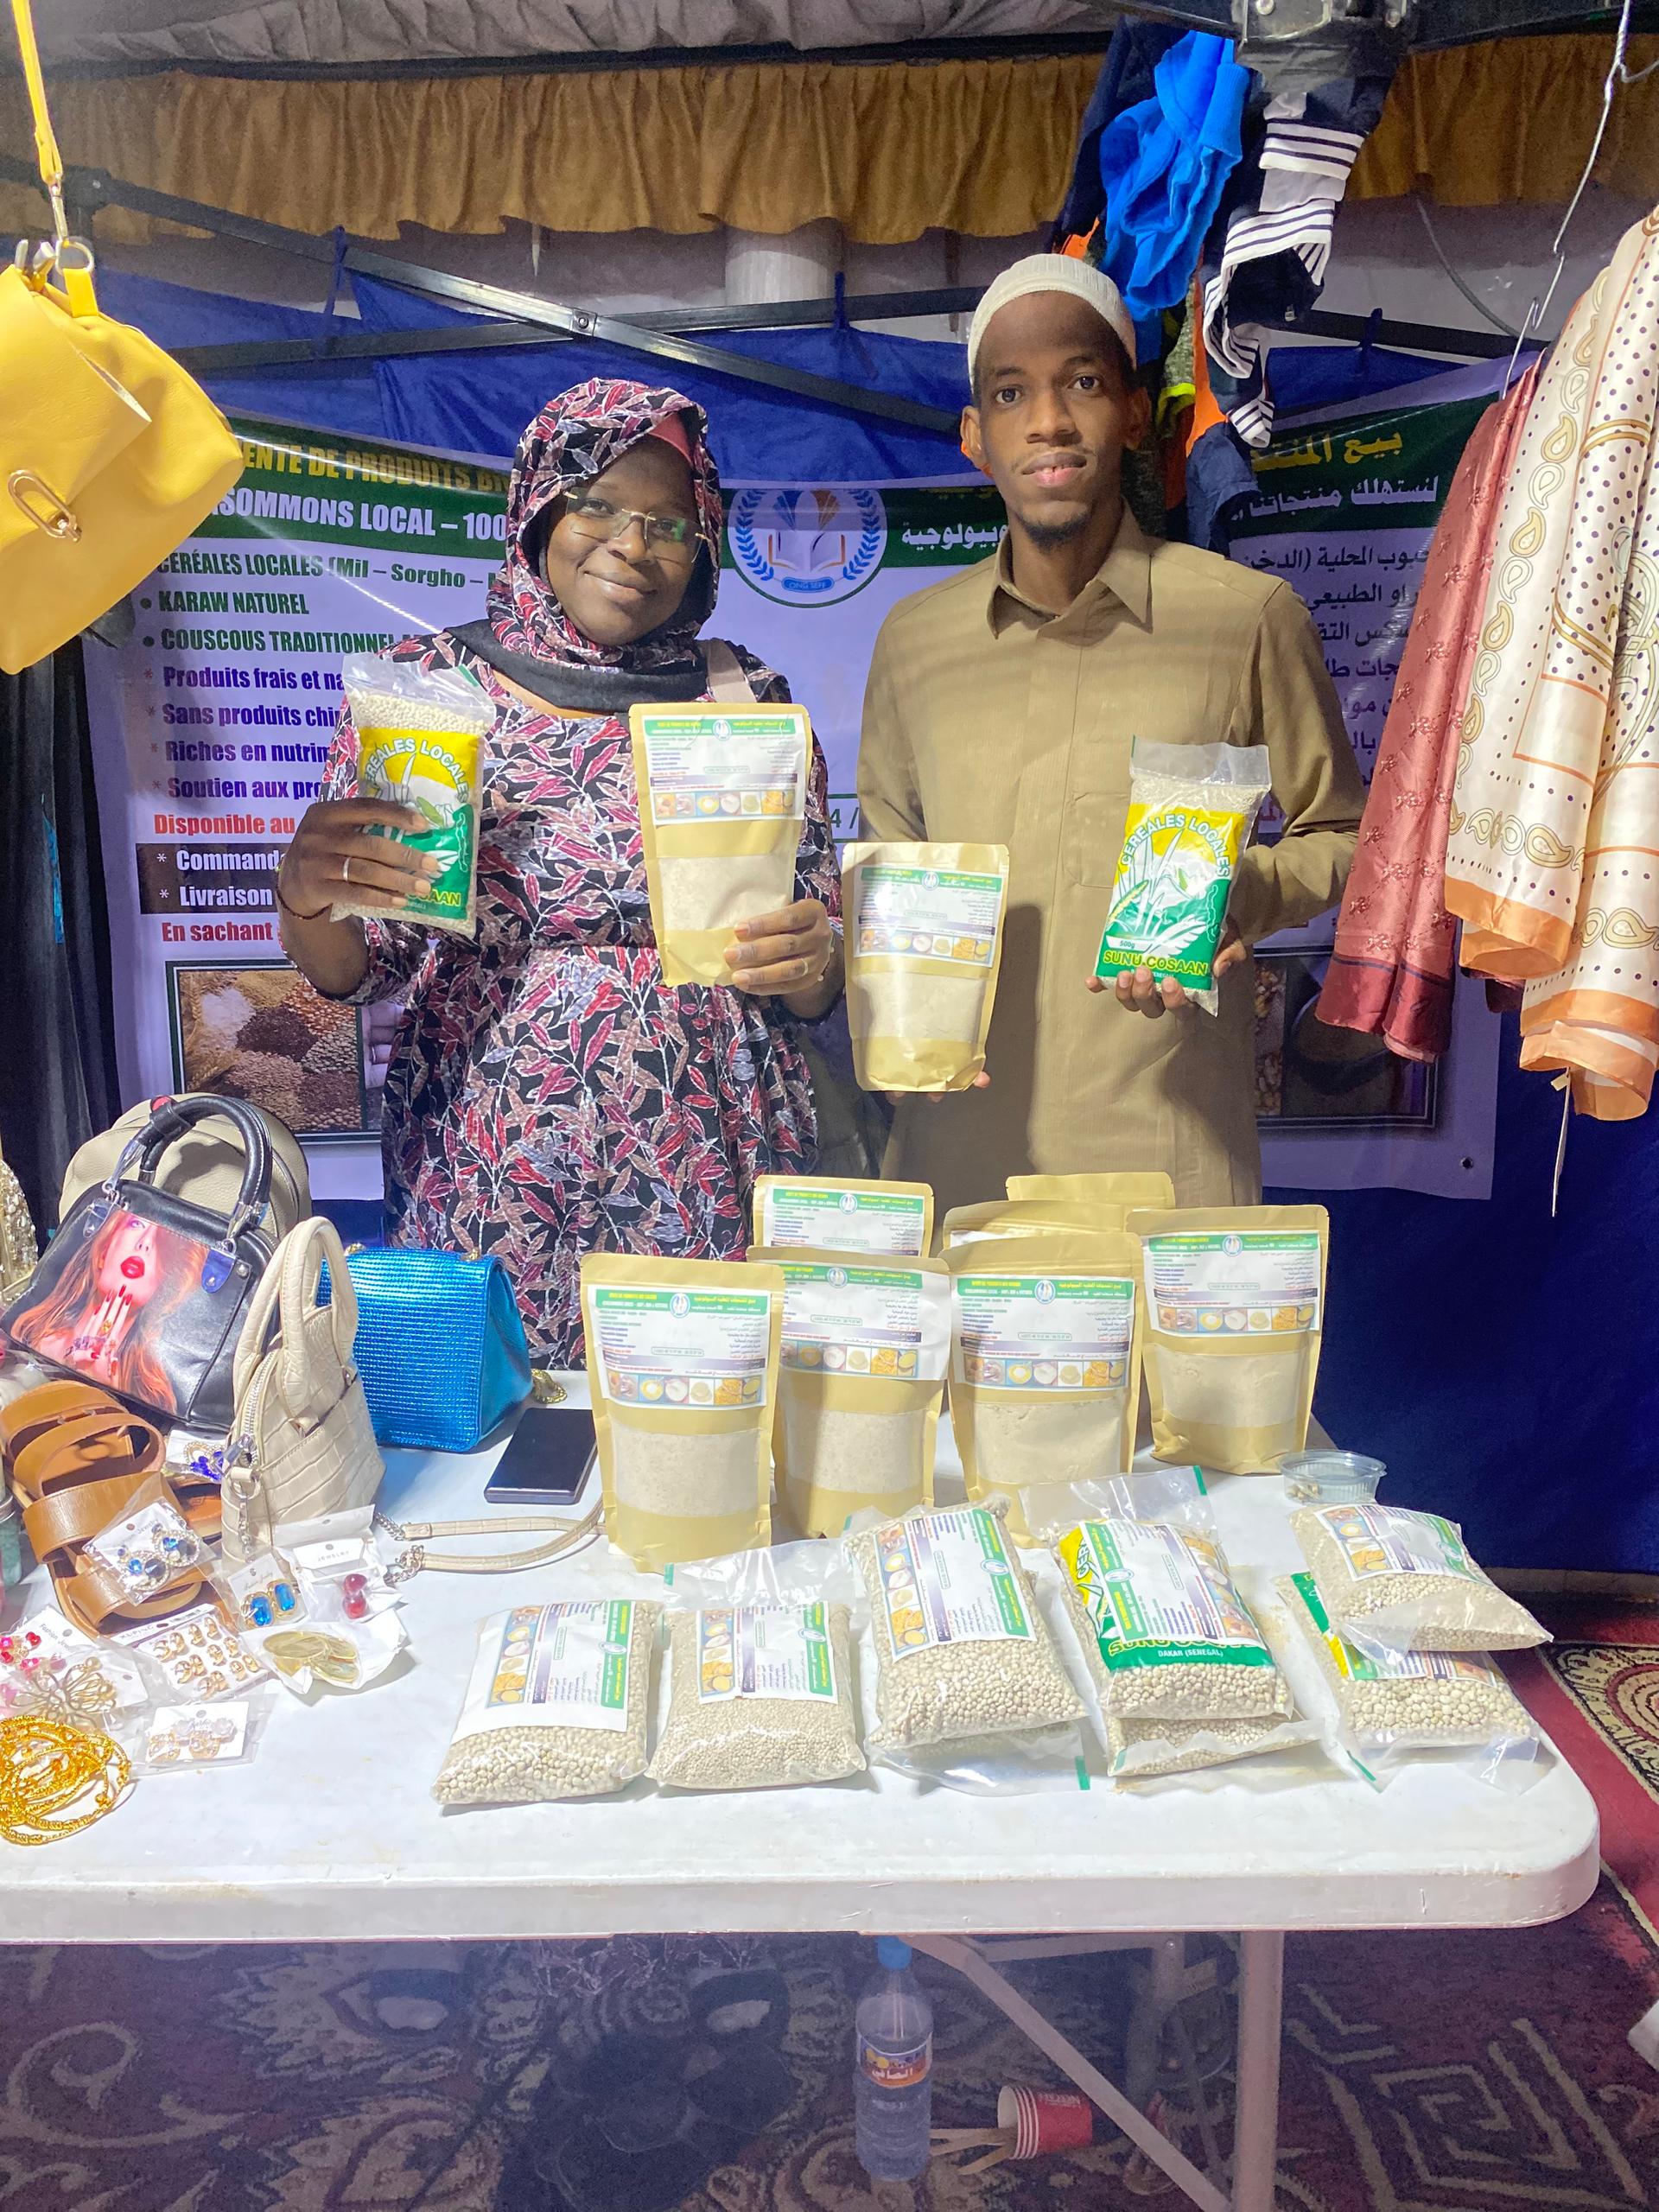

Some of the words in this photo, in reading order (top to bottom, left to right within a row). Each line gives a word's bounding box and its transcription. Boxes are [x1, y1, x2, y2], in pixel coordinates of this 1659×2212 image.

[239, 440, 302, 474] ENTE
[308, 446, 340, 479] DE
[346, 450, 471, 491] PRODUITS
[212, 487, 354, 528] SOMMONS
[360, 502, 436, 536] LOCAL
[245, 554, 324, 576] LOCALES
[391, 563, 466, 588] Sorgho
[158, 590, 229, 613] KARAW
[232, 592, 310, 614] NATUREL
[161, 628, 266, 652] COUSCOUS
[163, 666, 251, 688] Produits
[254, 668, 298, 690] frais
[302, 670, 321, 690] et
[162, 703, 214, 725] Sans
[219, 705, 302, 727] produits
[165, 741, 236, 762] Riches
[241, 744, 267, 761] en
[420, 740, 469, 803] LOCALES
[167, 777, 247, 798] Soutien
[251, 780, 289, 798] aux
[154, 814, 265, 836] Disponible
[270, 817, 296, 834] au
[1121, 813, 1186, 866] CEREALES
[1189, 816, 1230, 878] LOCALES
[179, 886, 273, 906] Livraison
[162, 922, 186, 942] En
[190, 921, 273, 942] sachant
